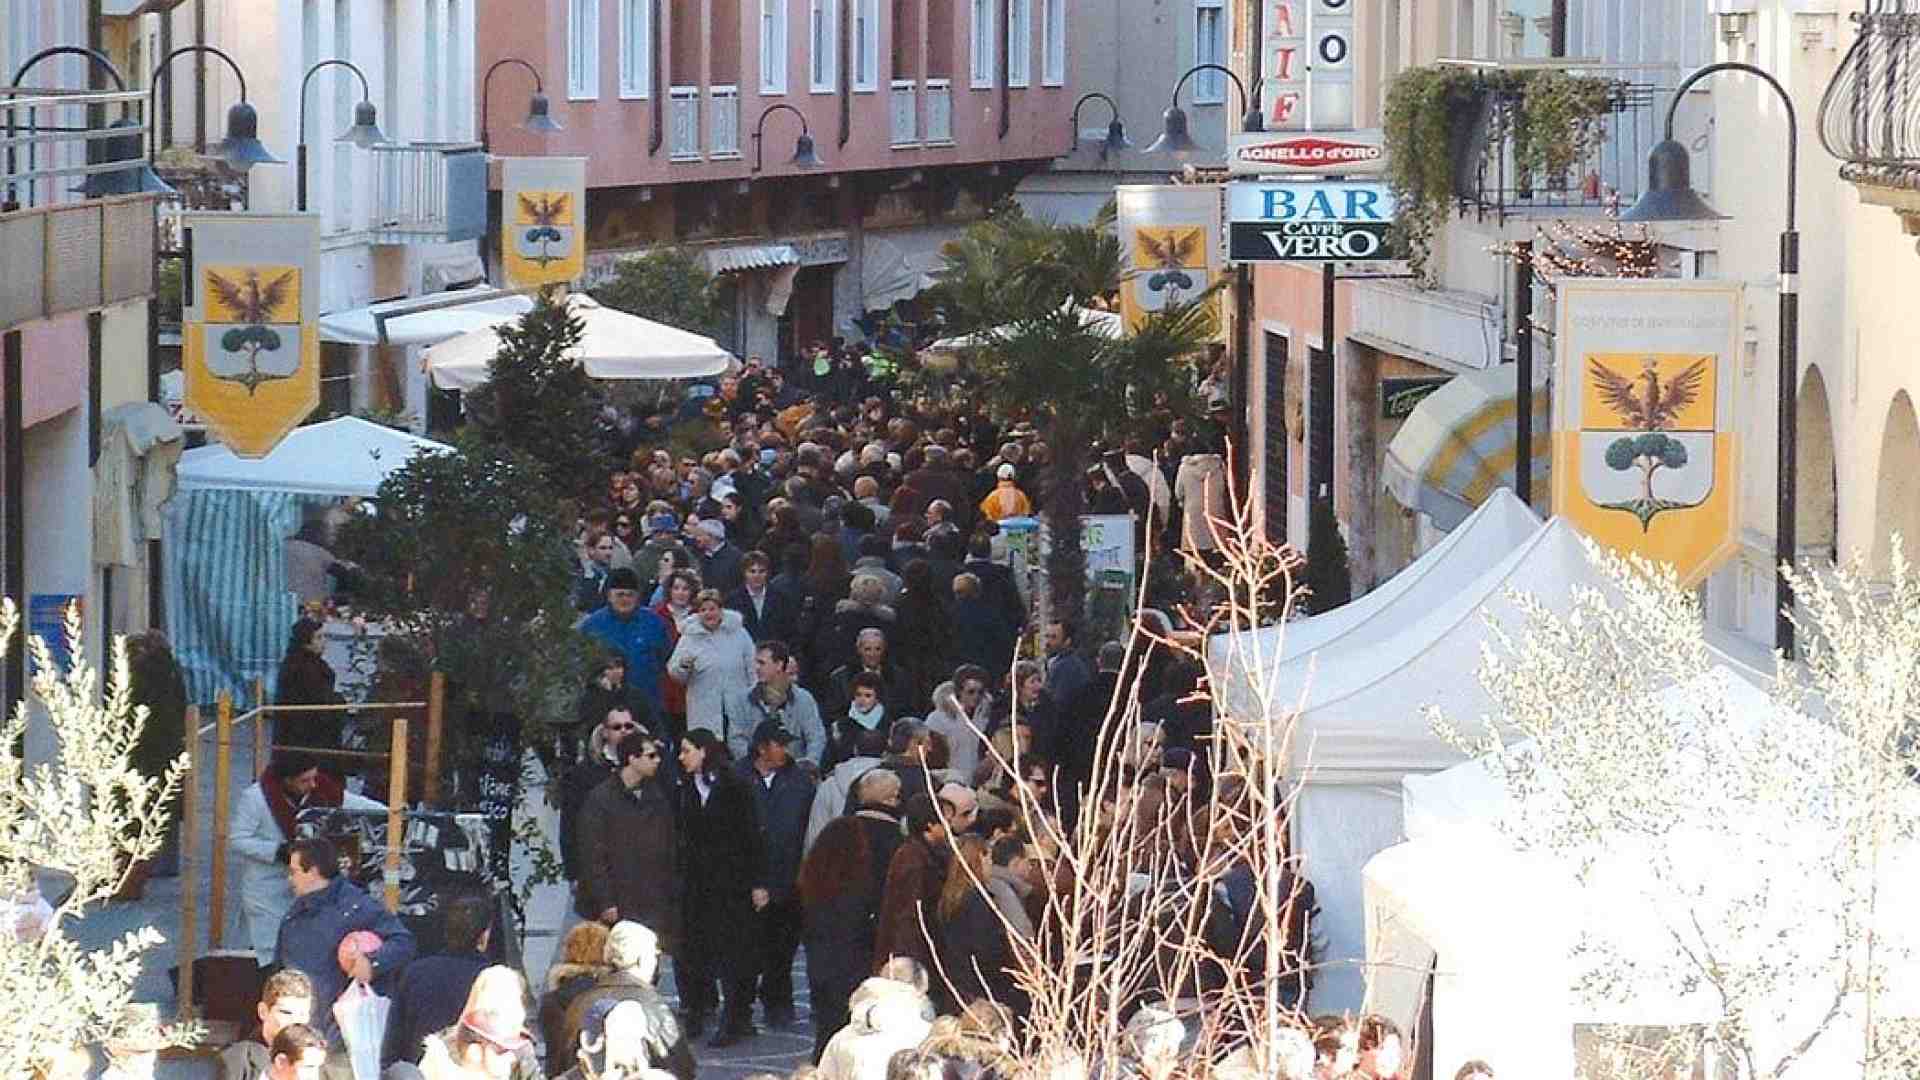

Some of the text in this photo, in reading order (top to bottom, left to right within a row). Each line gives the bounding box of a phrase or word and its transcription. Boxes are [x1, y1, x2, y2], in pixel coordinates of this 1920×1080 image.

[1319, 0, 1347, 63] O
[1240, 148, 1324, 159] AGNELLO
[1259, 189, 1382, 220] BAR
[1262, 230, 1379, 257] VERO
